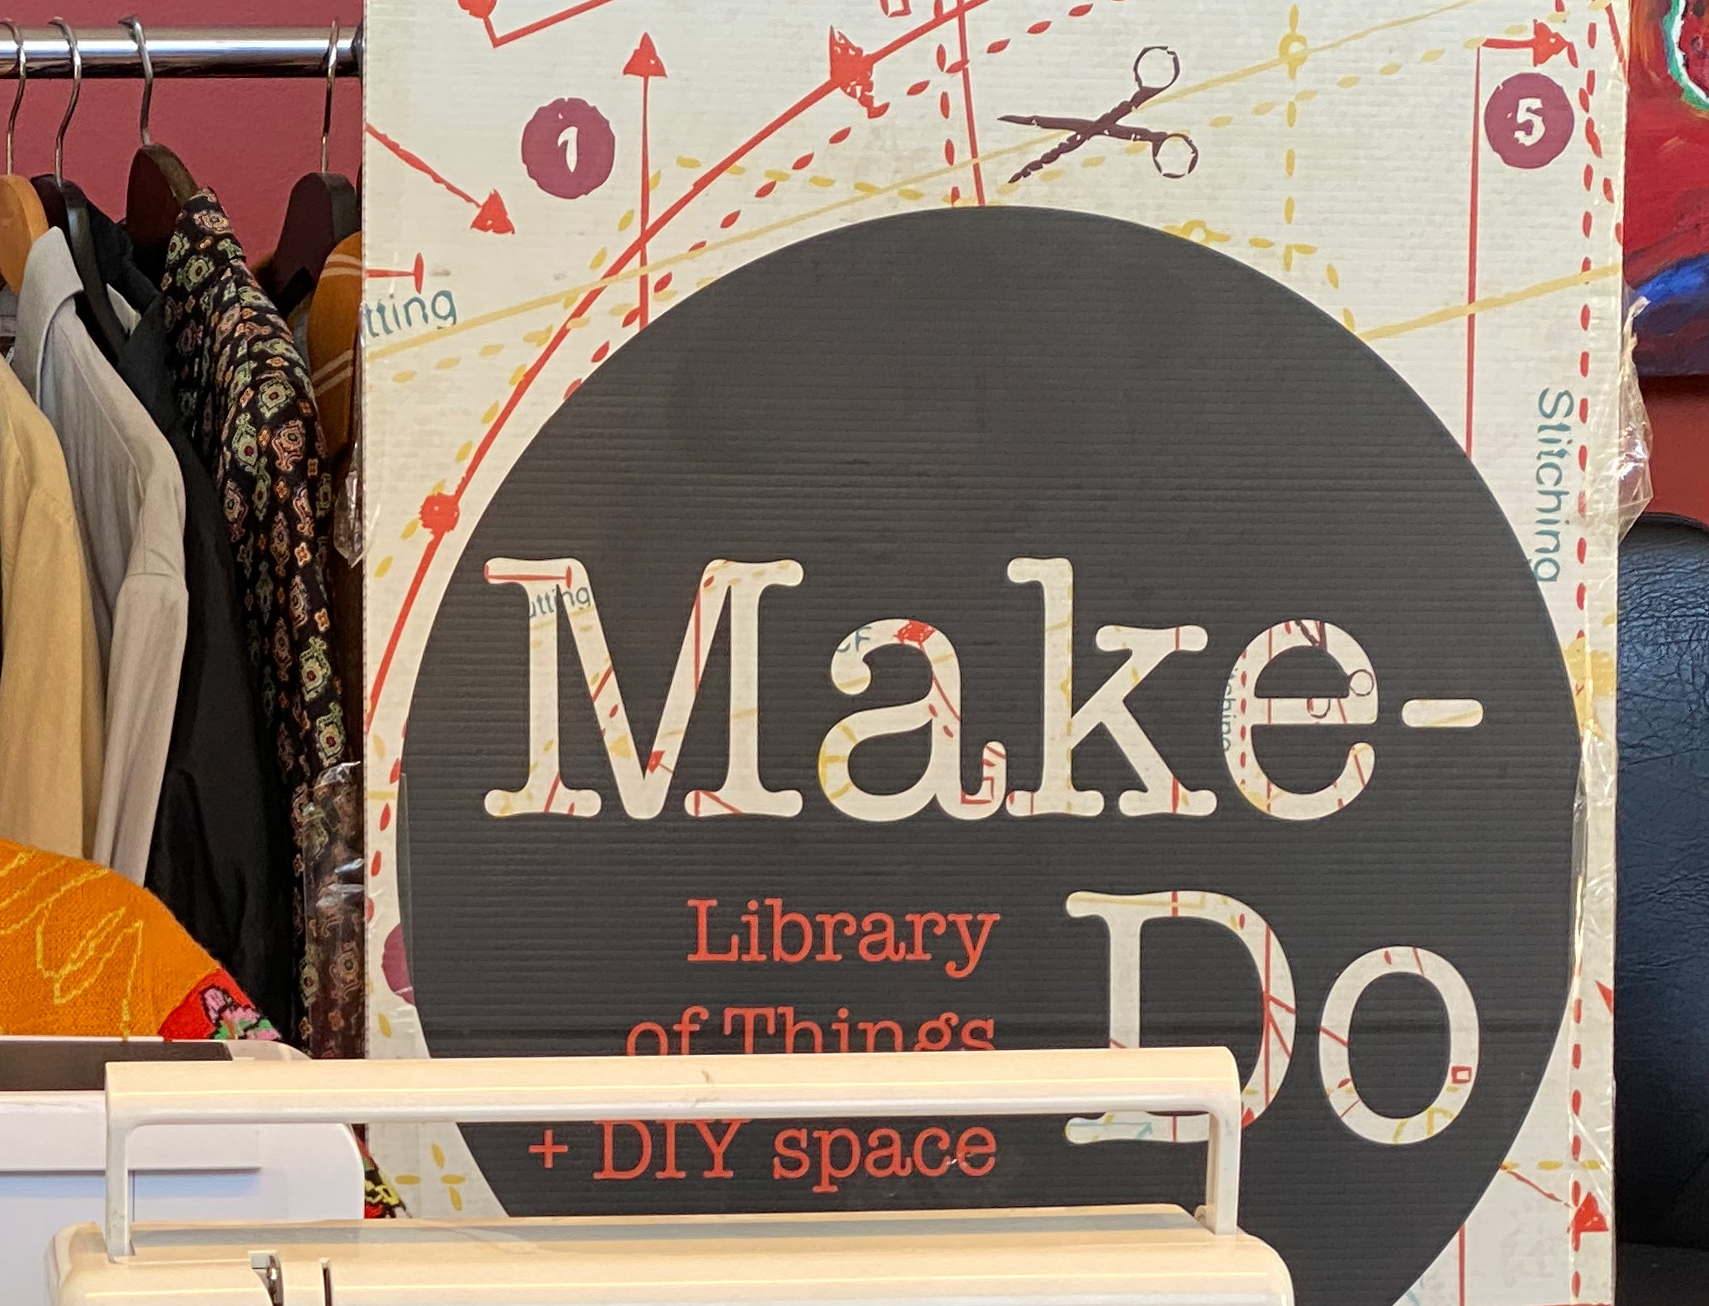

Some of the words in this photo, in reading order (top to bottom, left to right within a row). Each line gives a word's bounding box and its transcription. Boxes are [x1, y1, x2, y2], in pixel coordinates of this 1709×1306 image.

[557, 125, 578, 172] 1
[1513, 96, 1546, 146] 5
[484, 557, 1484, 823] Make-
[687, 898, 1001, 979] Library
[625, 1005, 710, 1056] of
[1065, 889, 1480, 1145] Do
[593, 1118, 752, 1180] DIY
[772, 1123, 997, 1193] space
